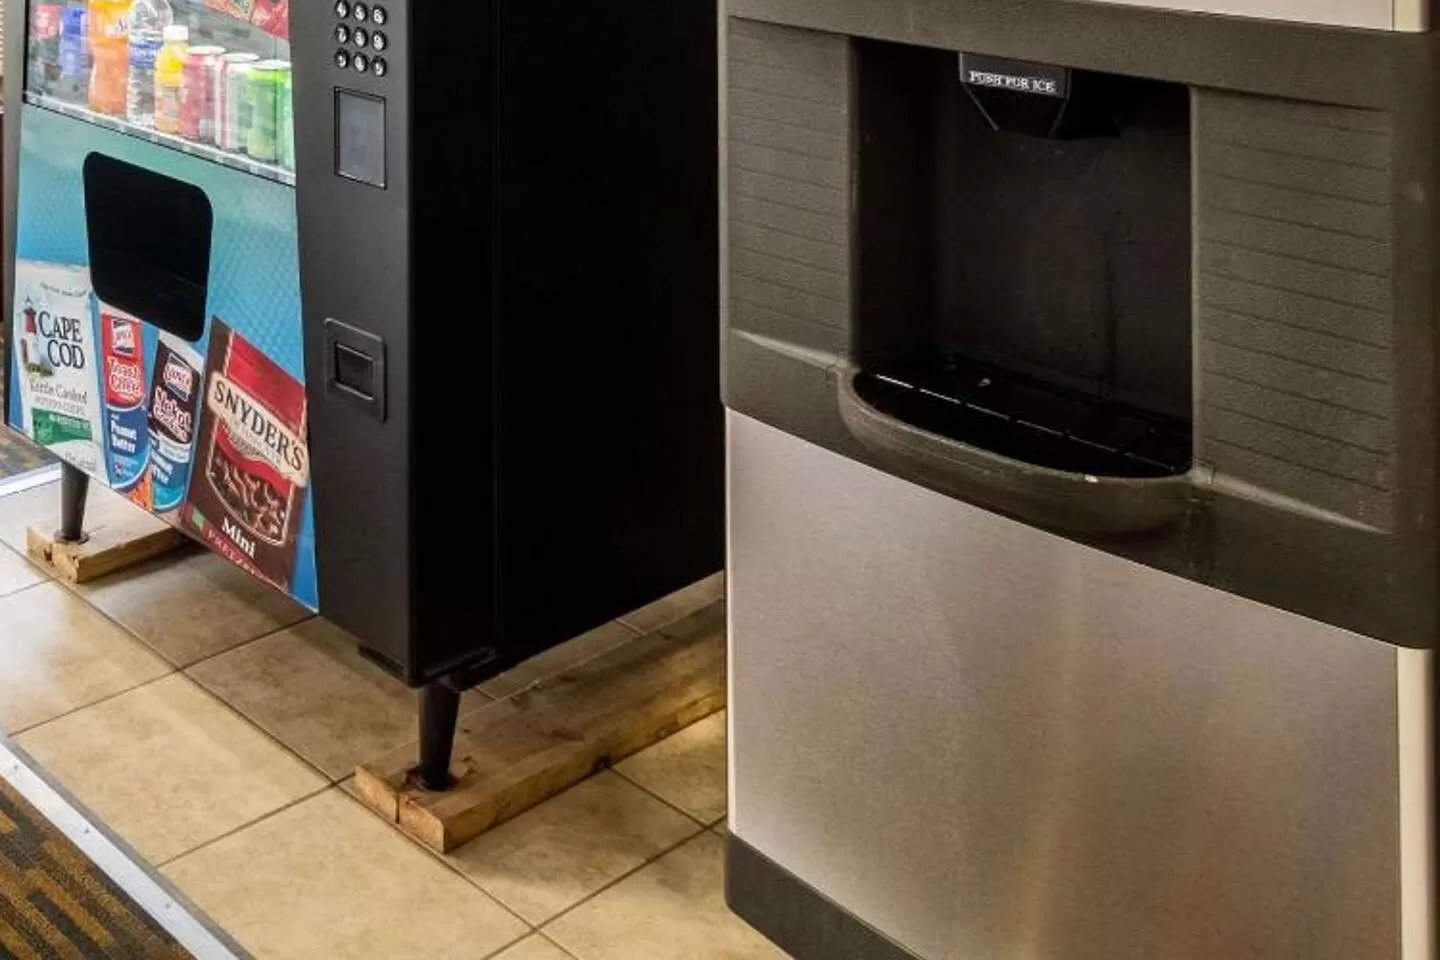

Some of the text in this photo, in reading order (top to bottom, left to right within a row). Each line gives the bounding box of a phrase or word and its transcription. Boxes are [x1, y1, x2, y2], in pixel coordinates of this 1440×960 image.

[968, 70, 1057, 93] PUSH FOR ICE
[38, 310, 84, 343] CAPE
[47, 339, 86, 370] COD
[213, 380, 305, 472] SNYDER'S
[221, 516, 257, 559] Mini
